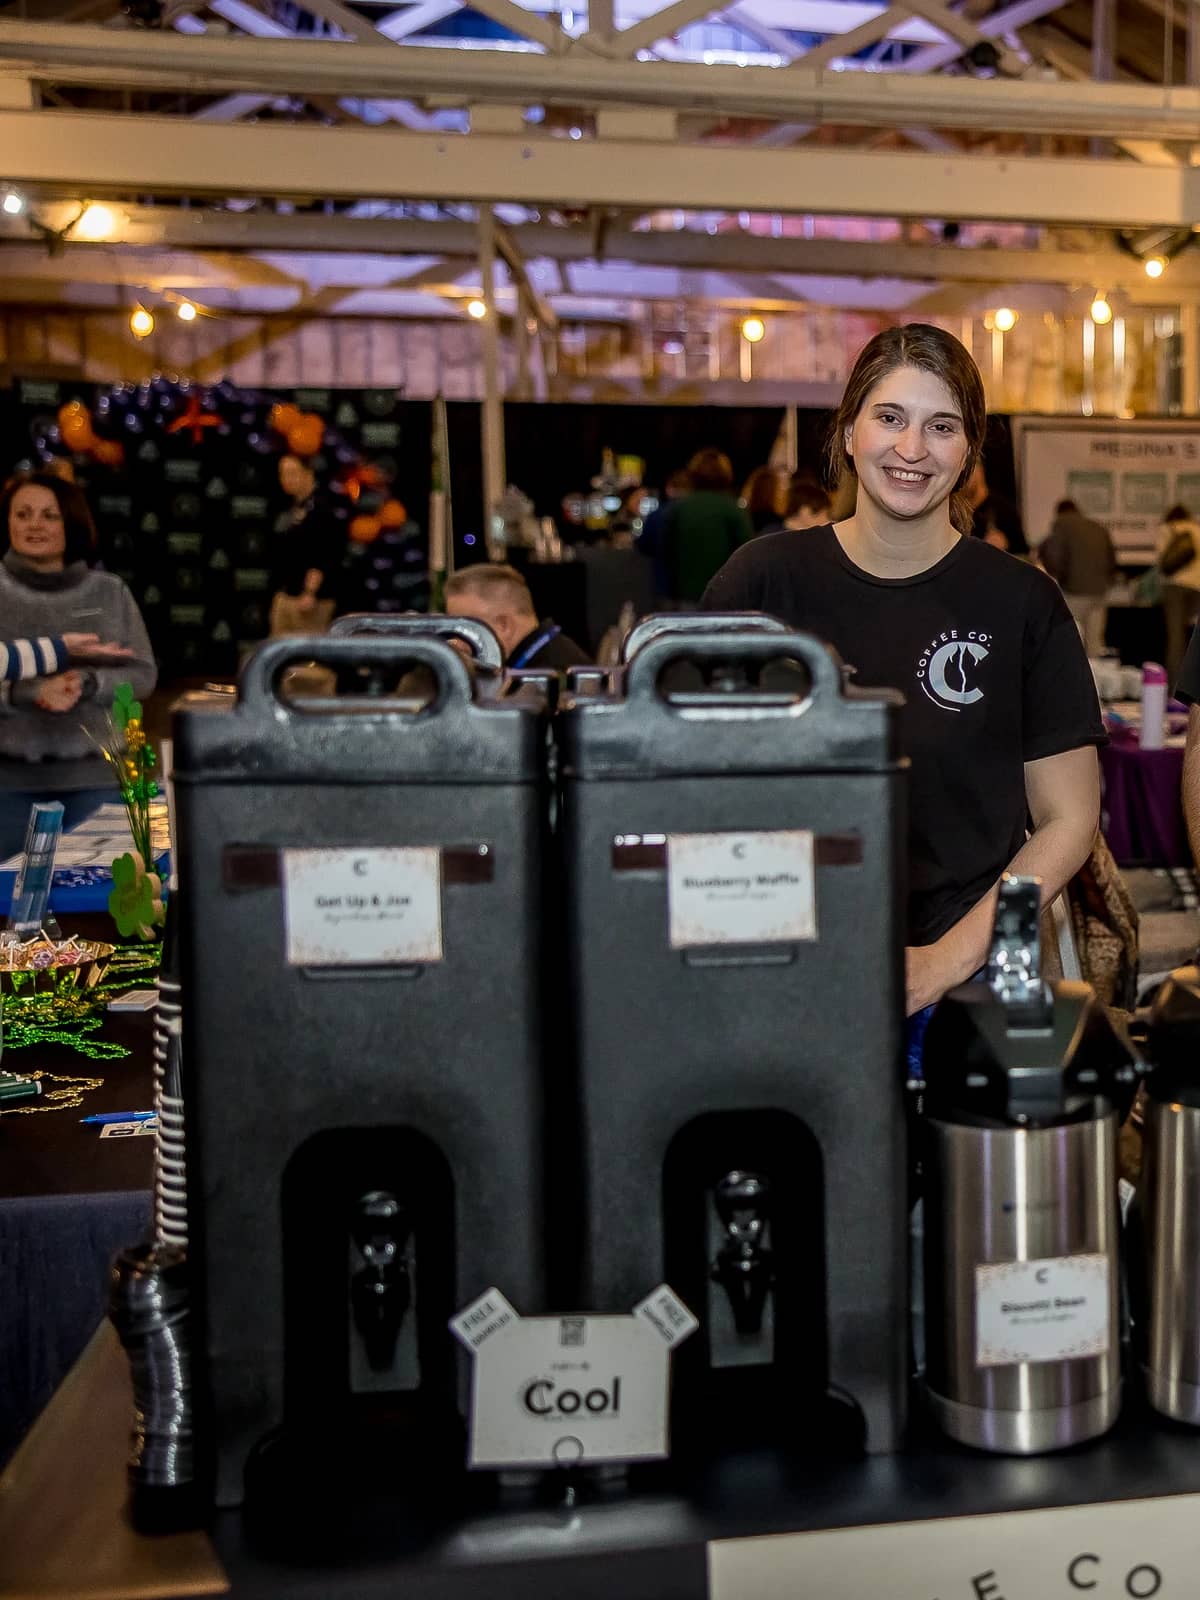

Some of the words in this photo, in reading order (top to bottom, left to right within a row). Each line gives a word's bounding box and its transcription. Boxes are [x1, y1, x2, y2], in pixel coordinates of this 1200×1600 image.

[916, 630, 958, 678] COFFEE
[682, 875, 751, 890] Blueberry
[757, 871, 799, 884] Waffle
[346, 895, 365, 909] Up
[524, 1375, 622, 1415] Cool
